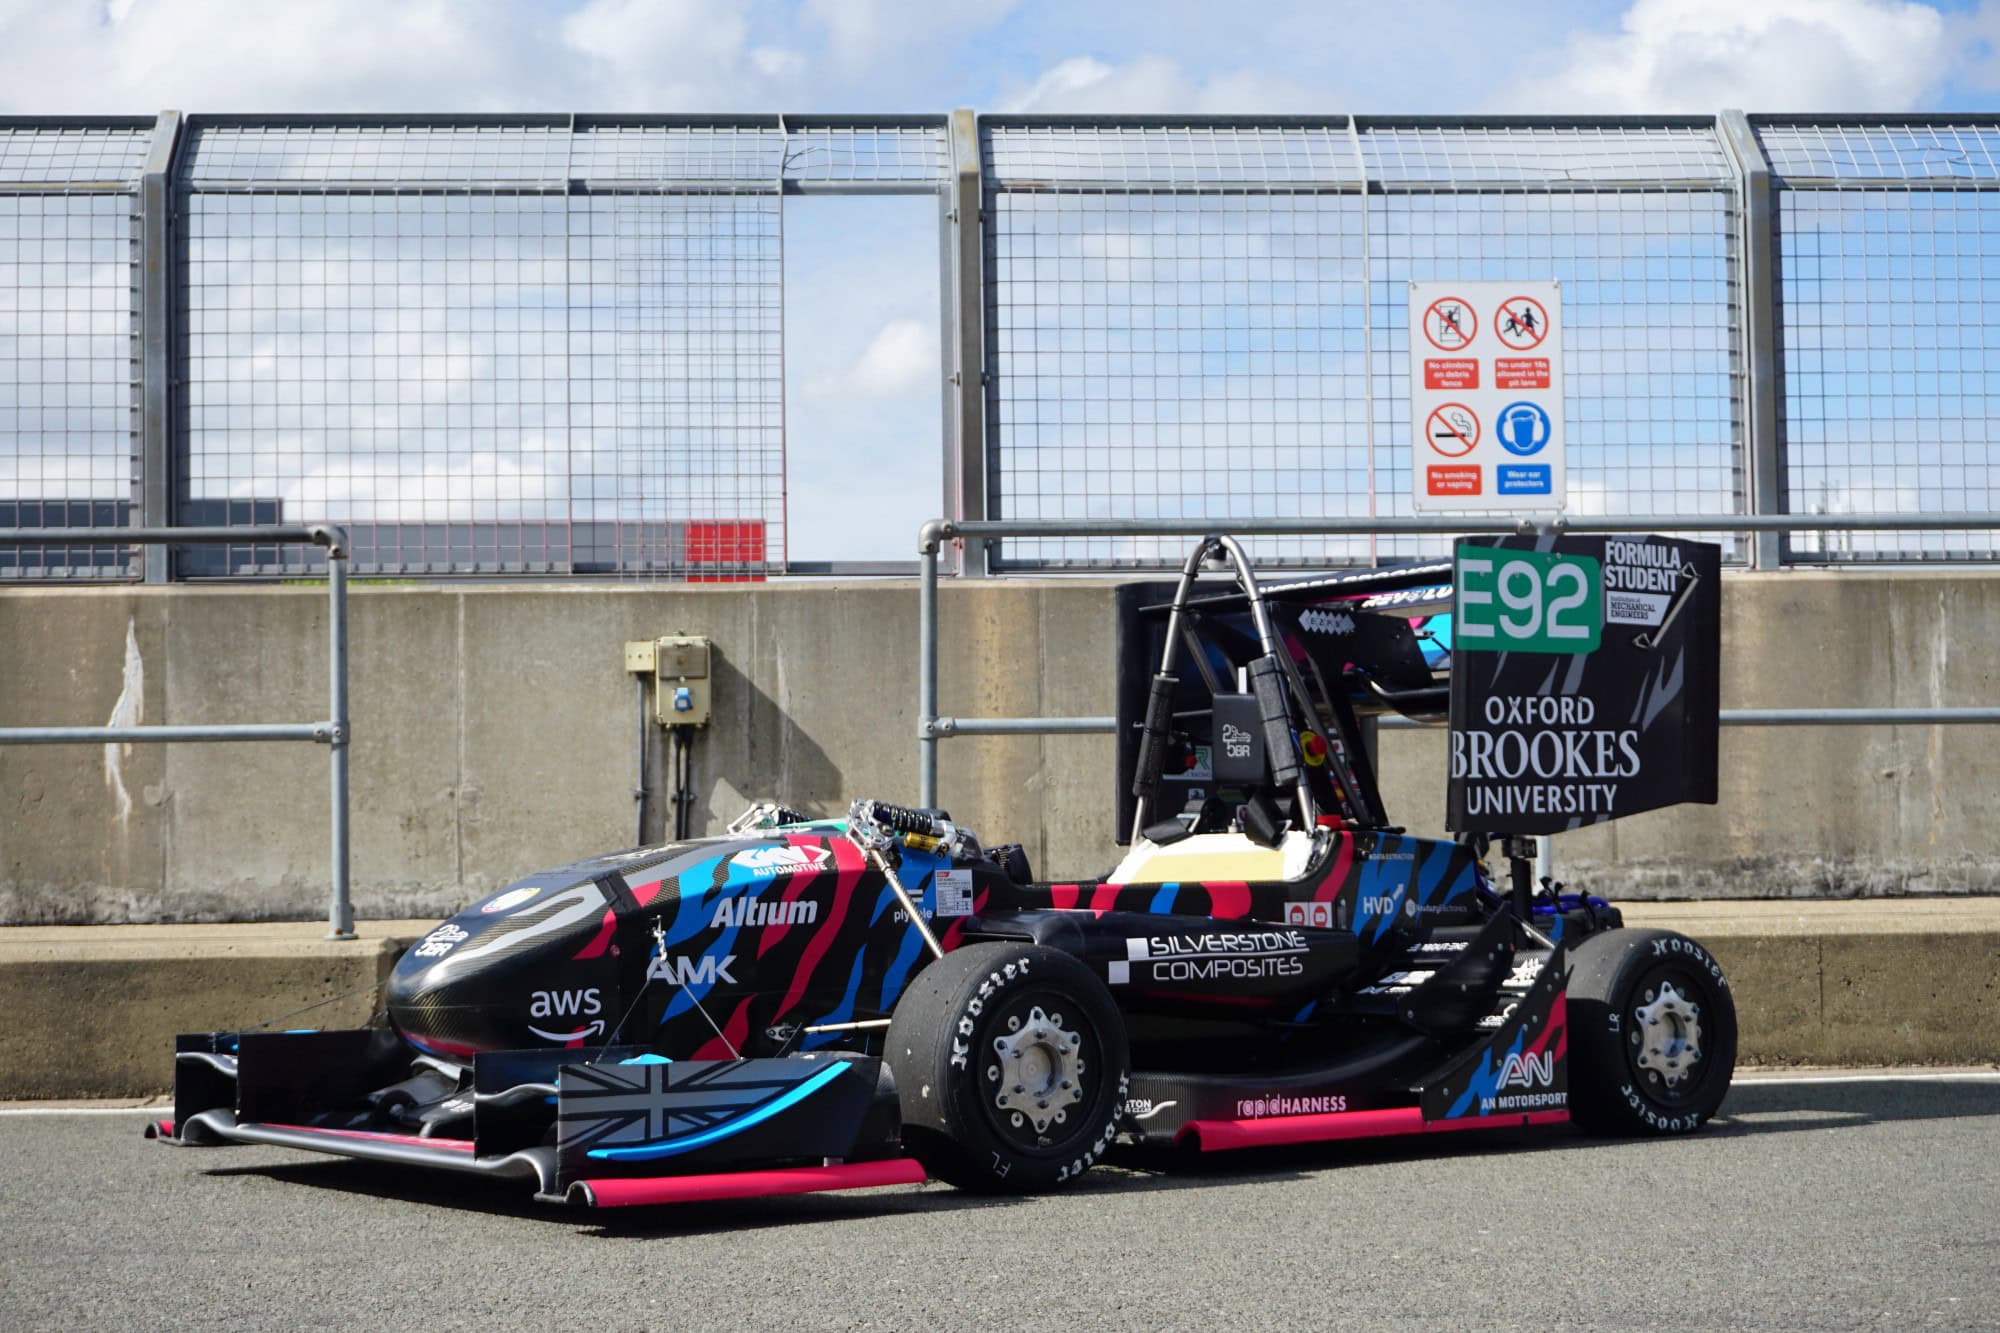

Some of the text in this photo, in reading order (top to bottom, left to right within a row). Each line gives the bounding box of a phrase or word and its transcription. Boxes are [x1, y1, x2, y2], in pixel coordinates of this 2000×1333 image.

[1429, 361, 1441, 369] No
[1497, 361, 1509, 369] No
[1527, 370, 1535, 378] in
[1432, 471, 1477, 481] No smoking
[1446, 480, 1473, 490] vaping
[1605, 540, 1682, 569] FORMULA
[1605, 565, 1679, 592] STUDENT
[1458, 557, 1590, 640] E92
[1611, 601, 1656, 612] MECHANICAL
[1611, 609, 1649, 620] ENGINEERS
[1485, 695, 1594, 725] OXFORD
[1452, 730, 1640, 779] BROOKES
[1467, 784, 1617, 815] UNIVERSITY
[753, 861, 828, 877] AUTOMOTIVE
[710, 896, 818, 928] Altium
[894, 907, 933, 924] plyle
[1363, 896, 1394, 915] HVD
[1150, 931, 1306, 956] SILVERSTONE
[646, 955, 738, 986] AMK
[1153, 957, 1303, 981] COMPOSITES
[530, 988, 601, 1018] aws
[1481, 1093, 1567, 1110] AN MOTORSPORT
